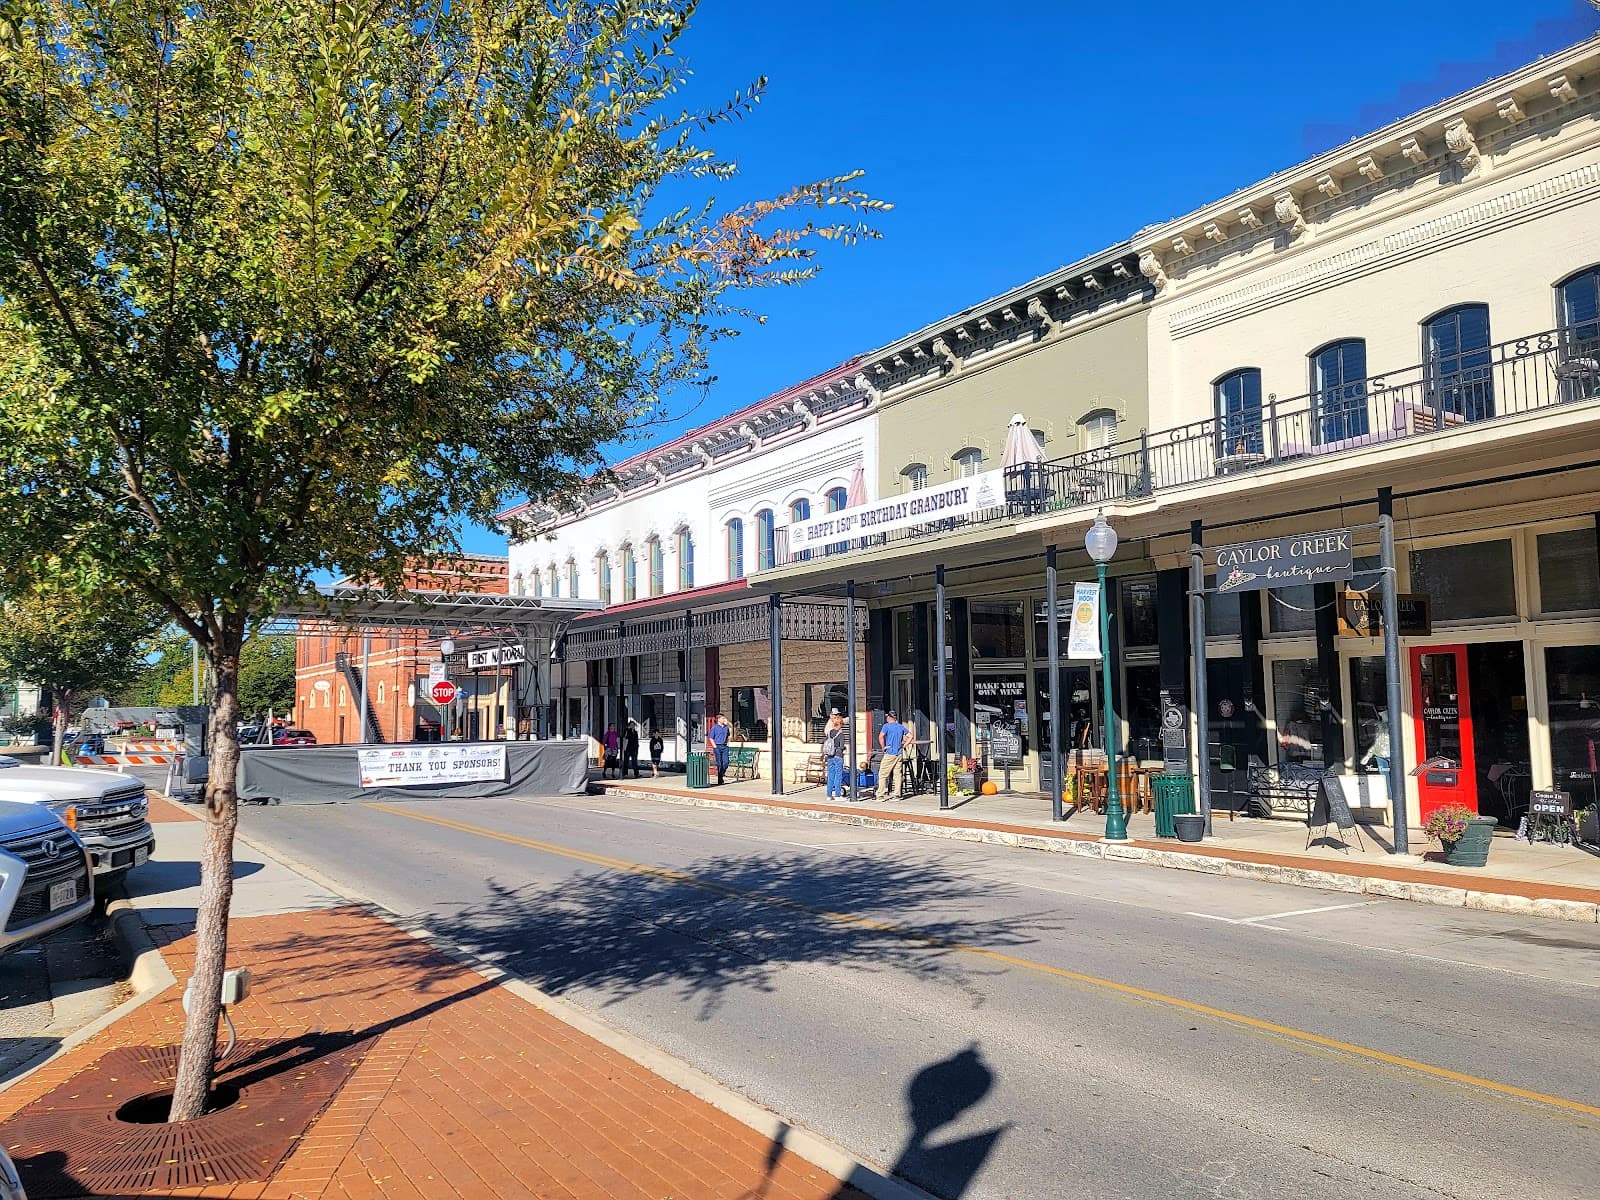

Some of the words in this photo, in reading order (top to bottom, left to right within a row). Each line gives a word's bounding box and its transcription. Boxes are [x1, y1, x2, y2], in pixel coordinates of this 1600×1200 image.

[808, 521, 834, 540] HAPPY
[860, 502, 908, 528] BIRTHDAY
[910, 487, 969, 515] GRANBURY
[1217, 544, 1282, 567] CAYLOR
[1290, 534, 1350, 557] CREEK
[1262, 563, 1350, 581] boutique
[433, 688, 454, 697] STOP
[975, 682, 1000, 690] MAKE
[388, 762, 422, 773] THANK
[429, 761, 446, 771] YOU
[453, 758, 501, 769] SPONSORS!
[1533, 803, 1565, 813] OPEN
